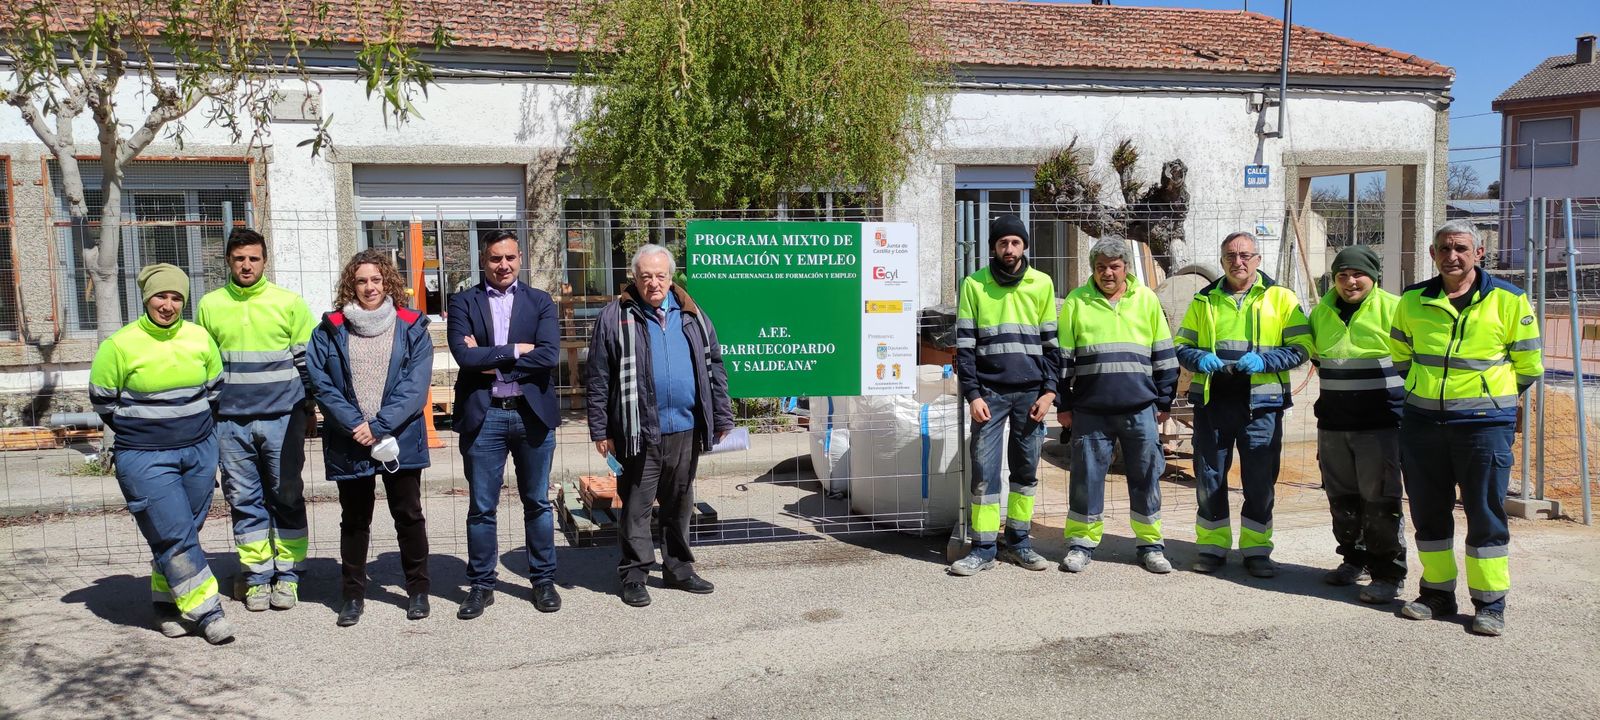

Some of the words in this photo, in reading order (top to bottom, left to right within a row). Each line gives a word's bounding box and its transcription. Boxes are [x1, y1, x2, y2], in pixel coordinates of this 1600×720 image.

[695, 233, 778, 246] PROGRAMA
[782, 234, 830, 246] MIXTO
[834, 234, 852, 246] DE
[692, 250, 780, 266] FORMACIÓN
[784, 254, 793, 266] Y
[797, 254, 856, 266] EMPLEO
[758, 327, 791, 338] A.F.E.
[732, 361, 741, 372] Y
